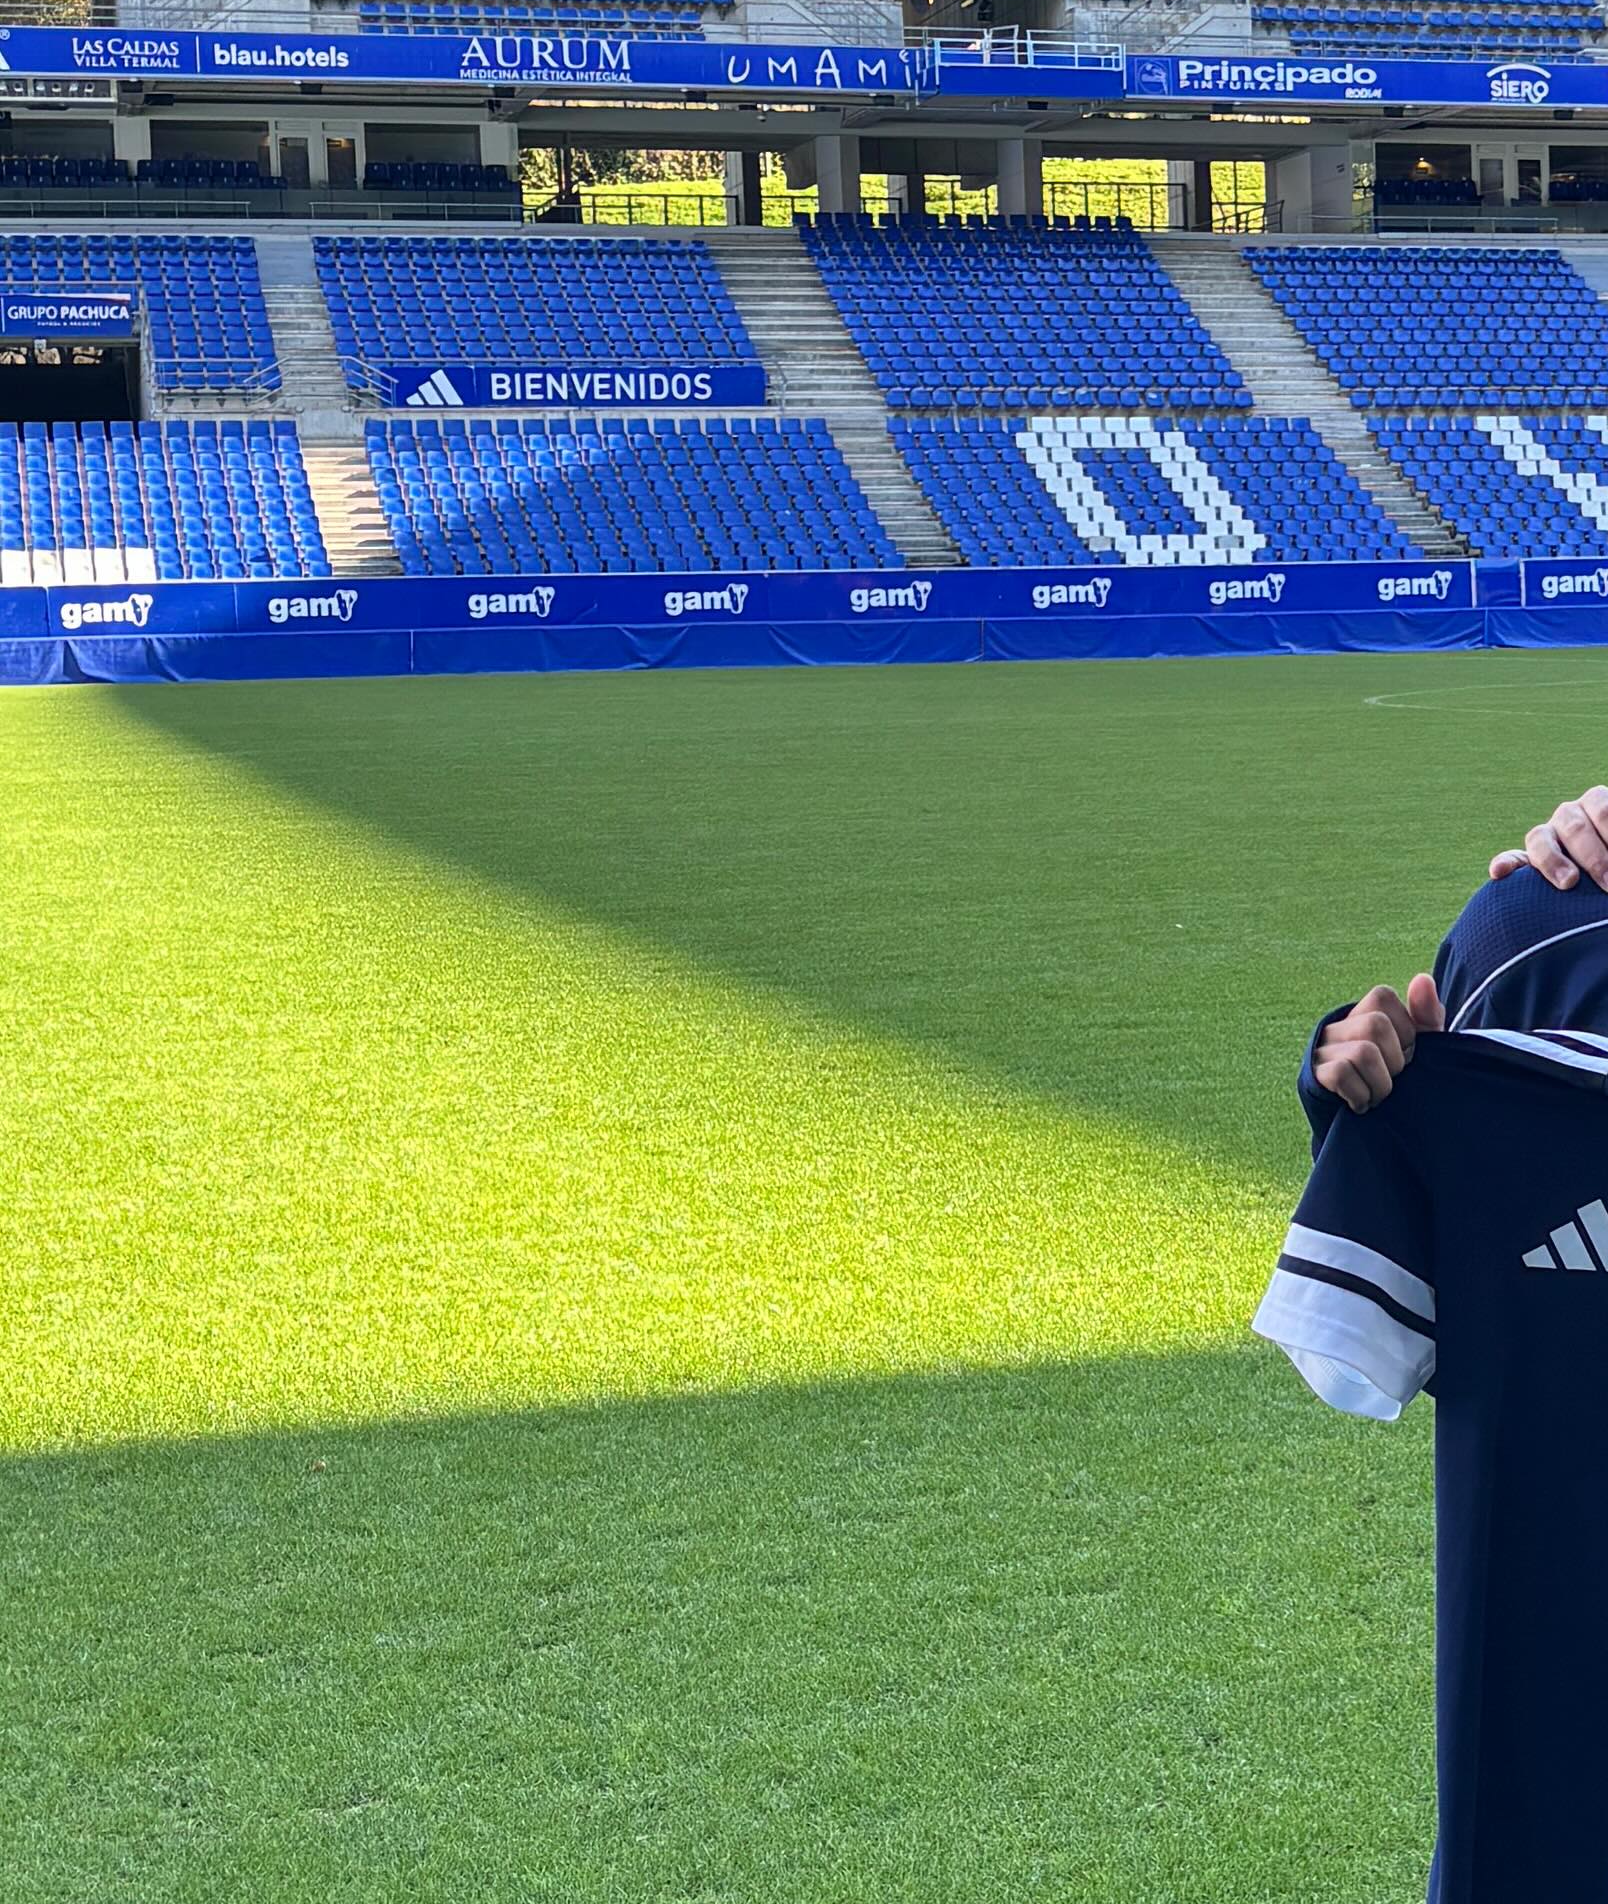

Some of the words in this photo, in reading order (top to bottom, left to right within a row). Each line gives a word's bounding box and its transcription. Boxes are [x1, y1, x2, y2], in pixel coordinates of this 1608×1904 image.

[73, 37, 102, 53] LAS
[106, 38, 179, 56] CALDAS
[214, 43, 350, 67] blau.hotels
[461, 37, 632, 70] AURUM
[74, 55, 116, 67] VILLA
[122, 55, 181, 69] TERMAL
[460, 69, 519, 79] MEDICINA
[522, 68, 574, 81] ESTÉTICA
[1179, 60, 1377, 91] Principado
[7, 306, 58, 319] GRUPO
[60, 306, 130, 320] PACHUCA
[490, 372, 713, 401] BIENVENIDOS
